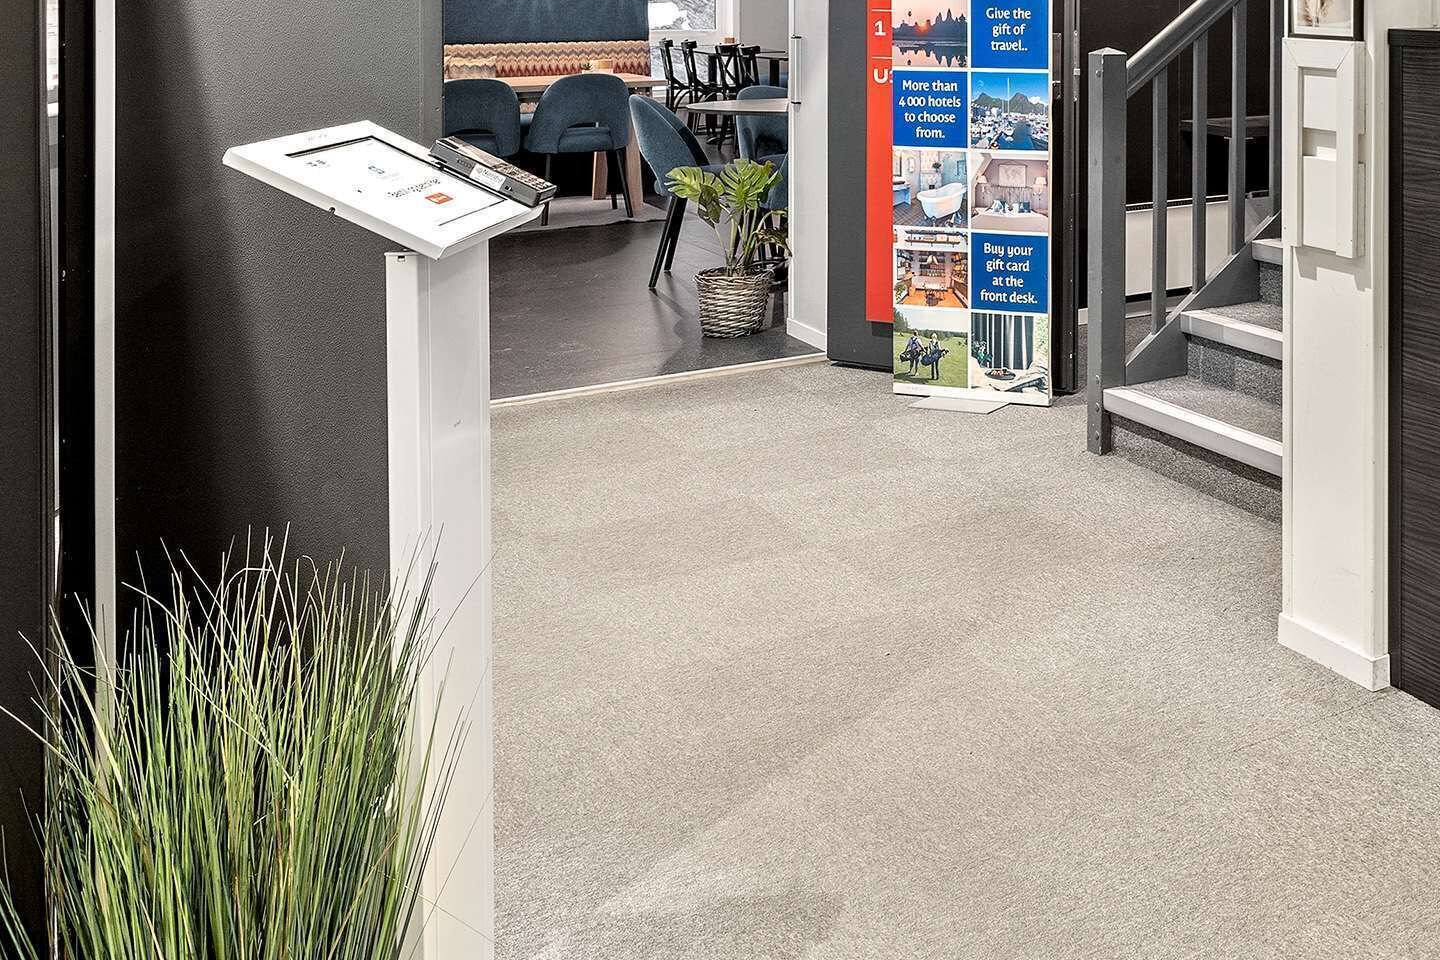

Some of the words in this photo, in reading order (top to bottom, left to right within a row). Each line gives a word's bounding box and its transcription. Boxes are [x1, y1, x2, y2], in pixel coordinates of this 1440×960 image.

[986, 7, 1010, 19] Give
[1013, 7, 1031, 19] the
[874, 21, 886, 36] 1
[992, 23, 1011, 37] gift
[1013, 23, 1026, 35] of
[902, 80, 929, 91] More
[932, 80, 958, 92] than
[928, 95, 961, 107] hotels
[904, 111, 916, 122] to
[918, 111, 956, 123] choose
[916, 126, 946, 138] from.
[983, 242, 1004, 257] Buy
[1007, 245, 1033, 258] your
[986, 258, 1004, 272] gift
[1006, 260, 1030, 272] card
[992, 276, 1003, 286] at
[1005, 275, 1024, 287] the
[980, 289, 1008, 302] front
[1009, 291, 1038, 304] desk.
